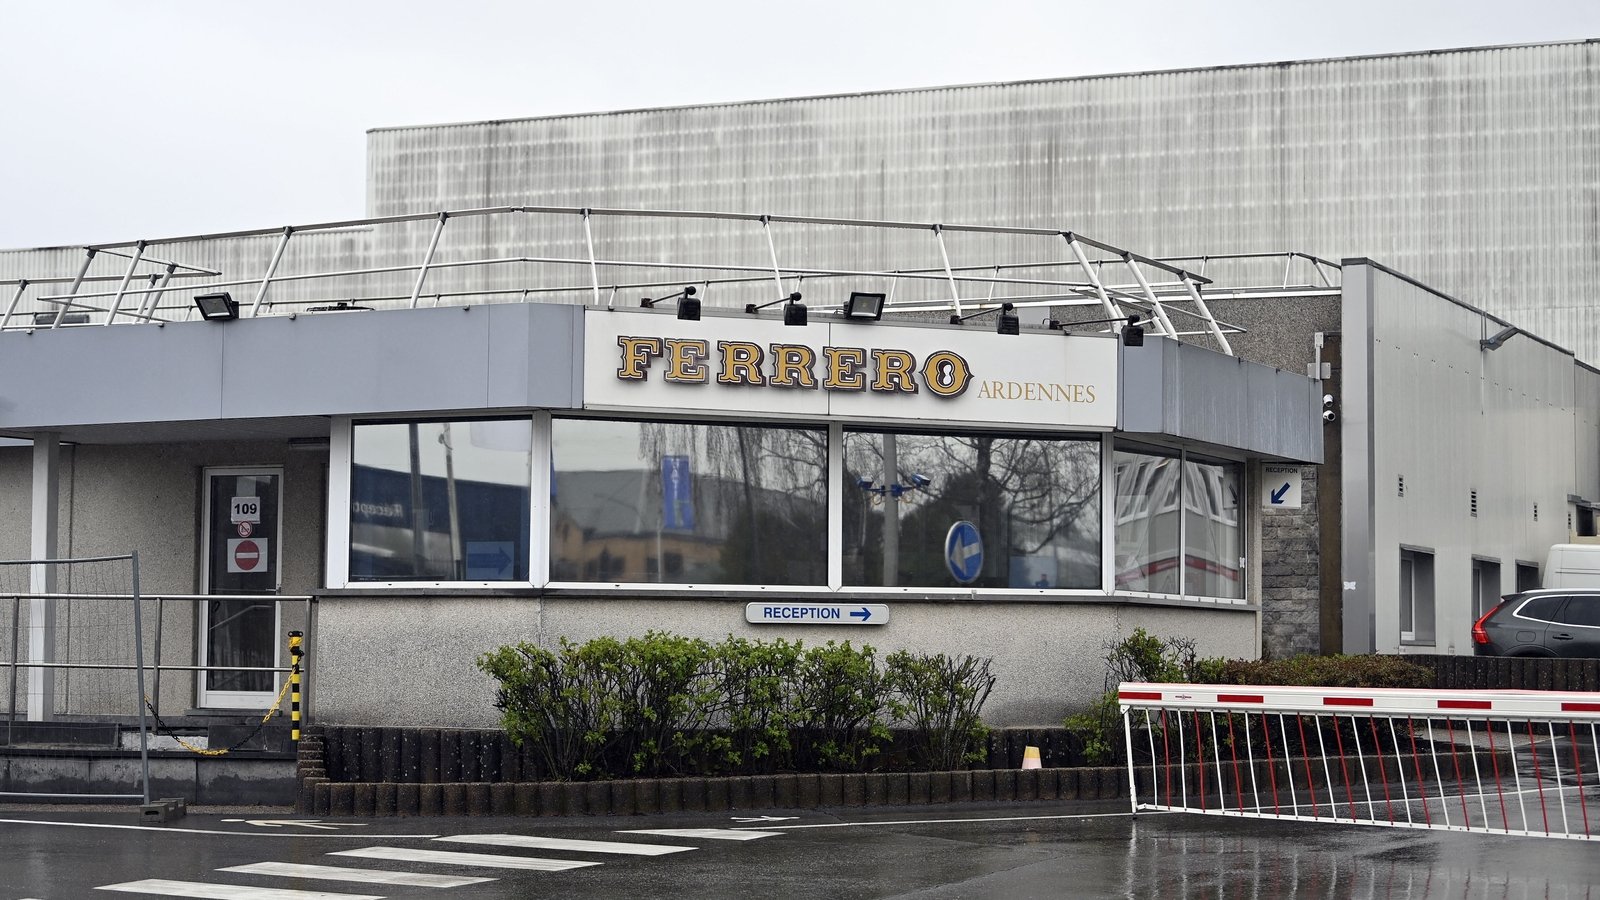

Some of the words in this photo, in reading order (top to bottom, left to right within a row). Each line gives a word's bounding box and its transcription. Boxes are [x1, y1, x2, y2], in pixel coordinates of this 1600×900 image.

[617, 335, 974, 398] FERRERO
[977, 380, 1096, 404] ARDENNES
[234, 503, 257, 515] 109
[763, 607, 840, 619] RECEPTION
